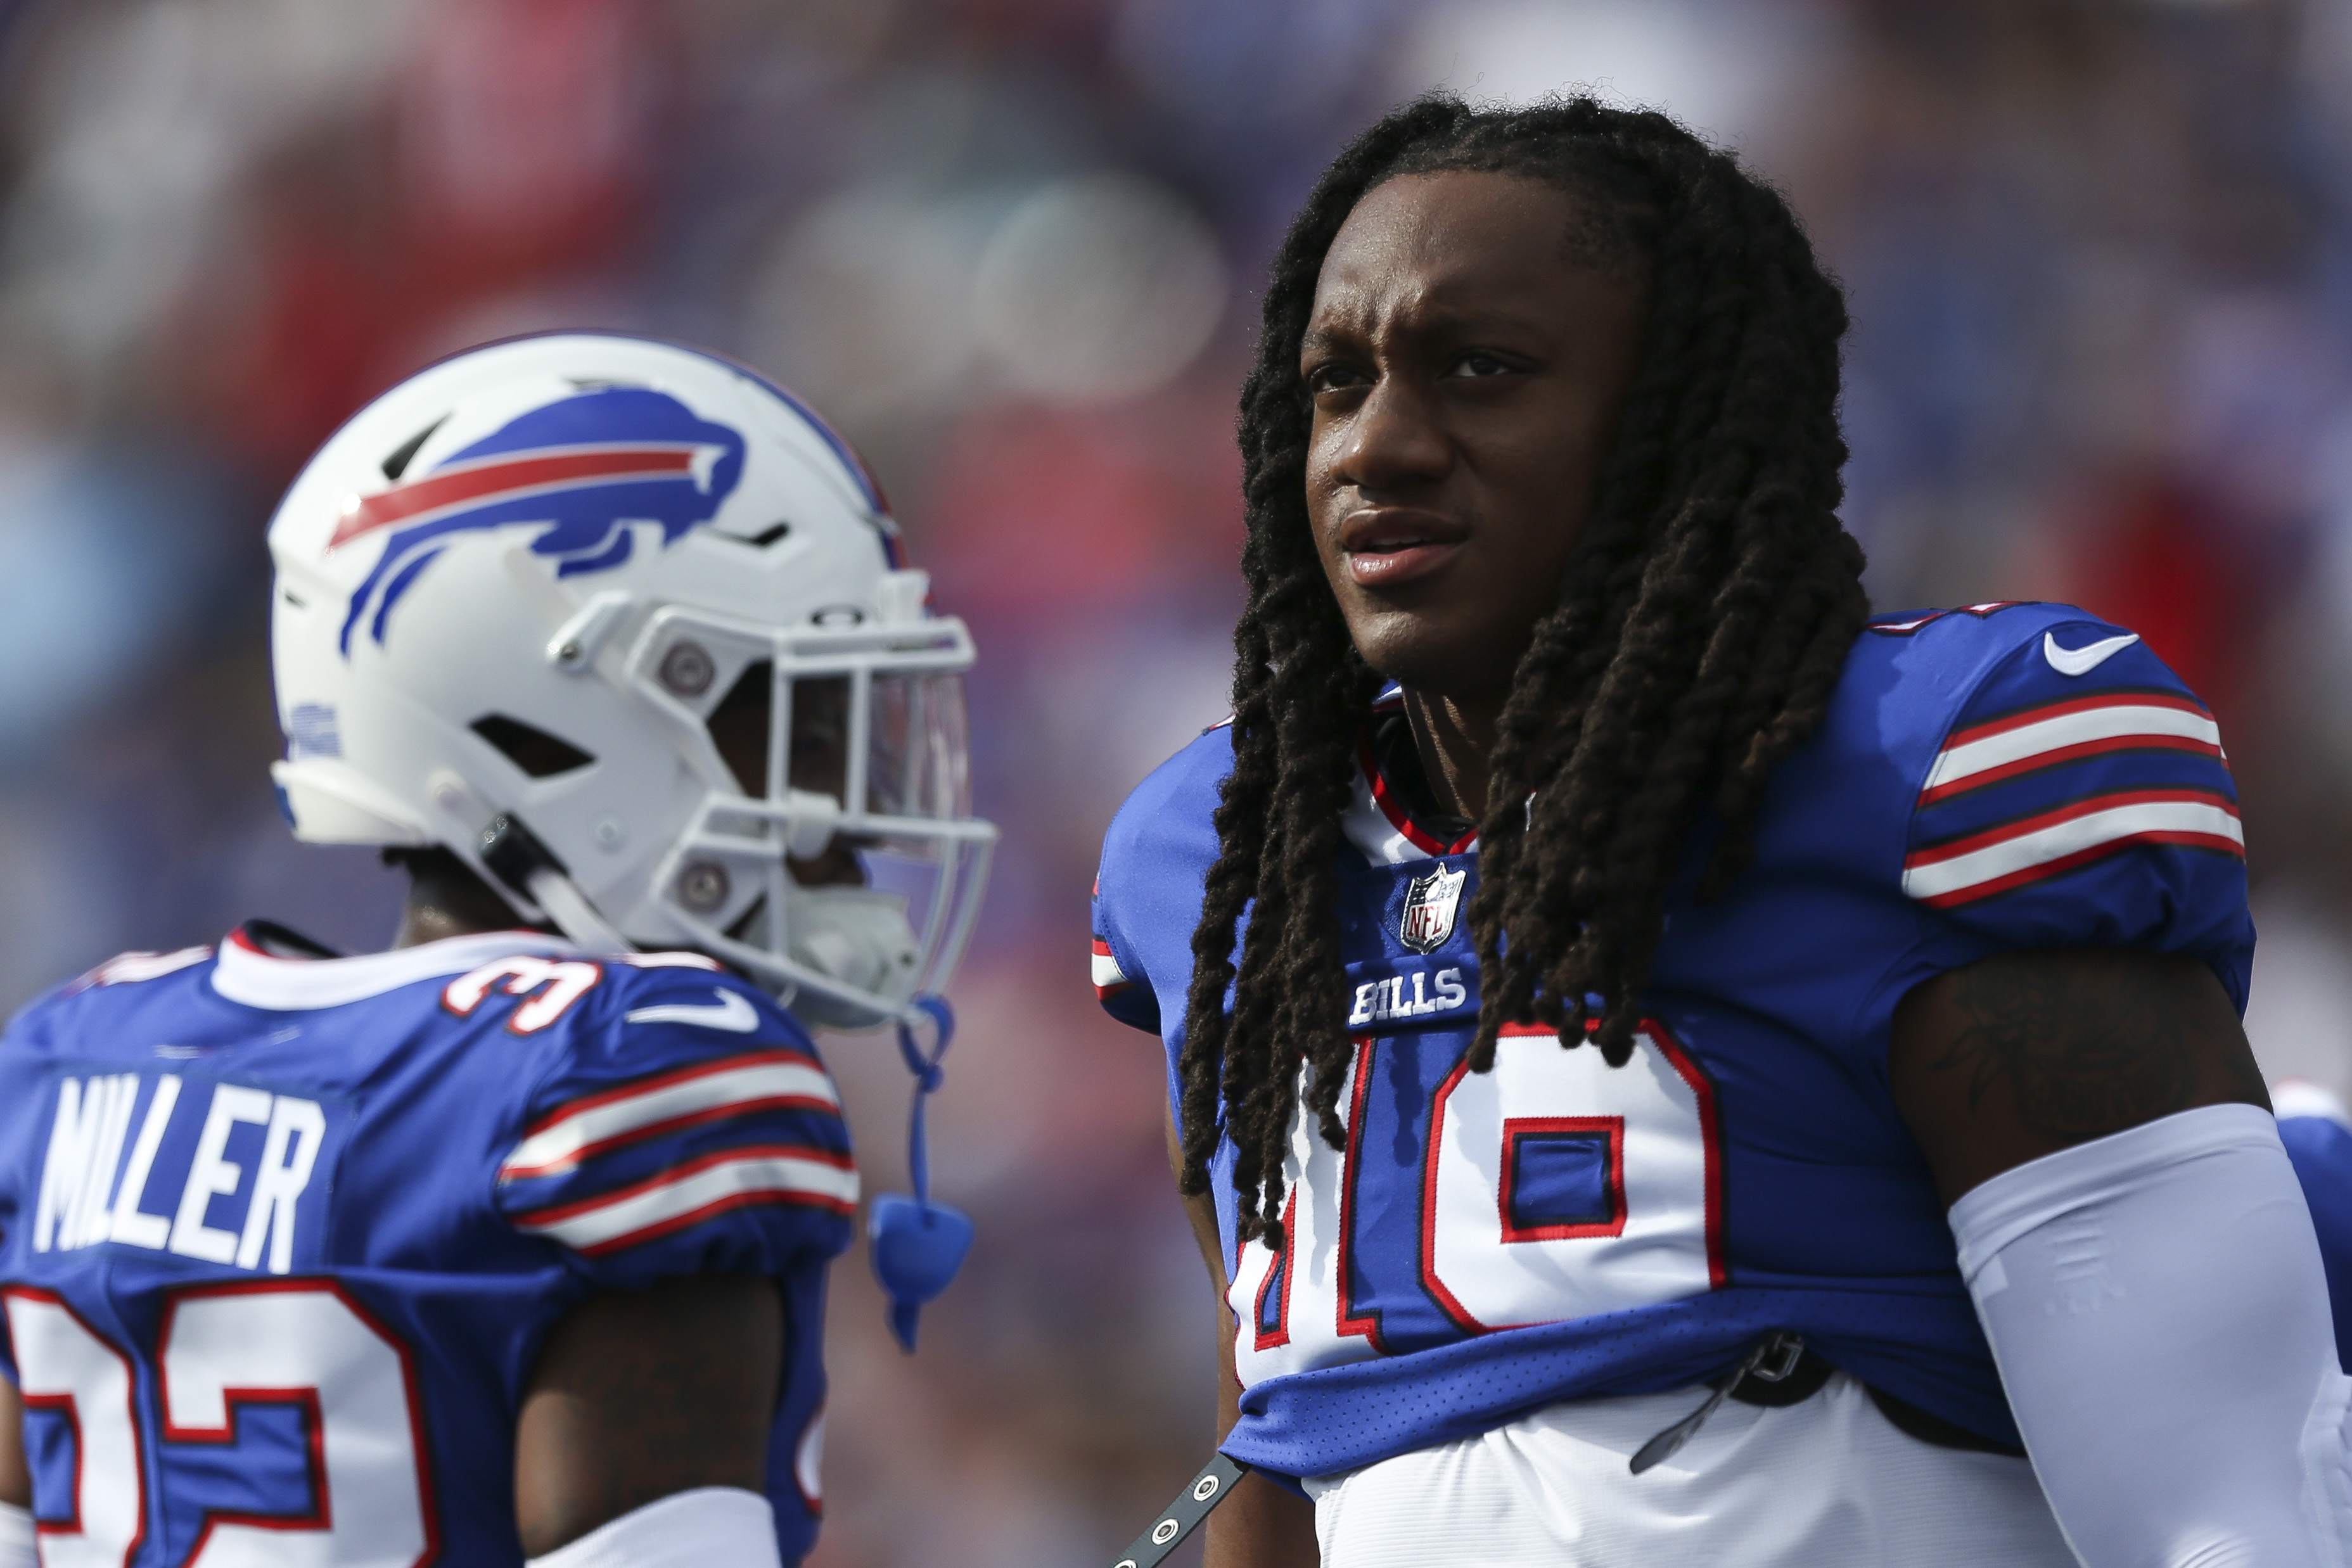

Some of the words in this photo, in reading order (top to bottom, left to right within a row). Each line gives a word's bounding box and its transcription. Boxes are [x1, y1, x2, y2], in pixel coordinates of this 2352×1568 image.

[1407, 905, 1443, 941] NFL
[1348, 967, 1466, 1026] BILLS
[32, 1071, 327, 1275] MILLER
